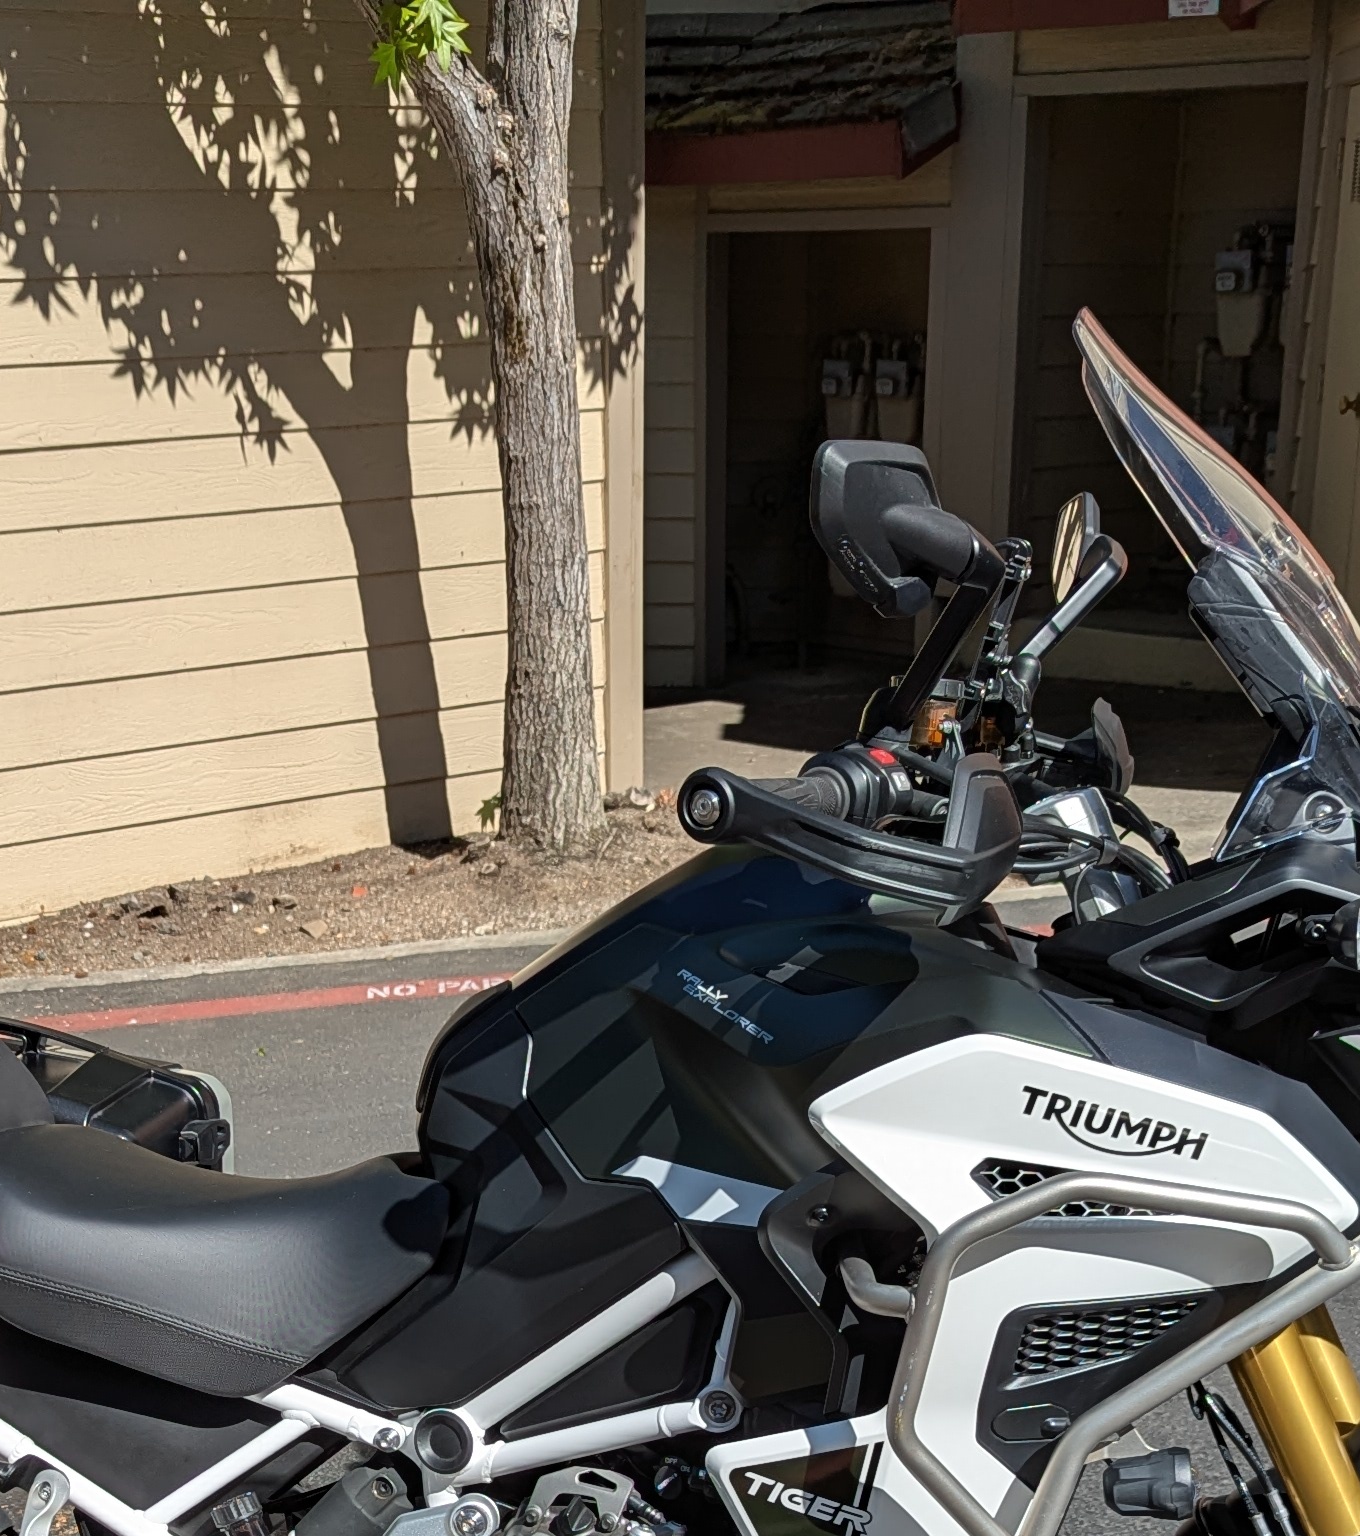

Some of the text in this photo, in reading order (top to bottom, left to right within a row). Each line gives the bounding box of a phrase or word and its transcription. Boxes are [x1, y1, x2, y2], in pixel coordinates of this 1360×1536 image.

[367, 984, 416, 999] NO
[676, 968, 729, 1000] RALLY
[682, 983, 774, 1045] EXPLORER
[1022, 1085, 1209, 1161] TRIUMPH
[744, 1471, 872, 1535] TIGER
